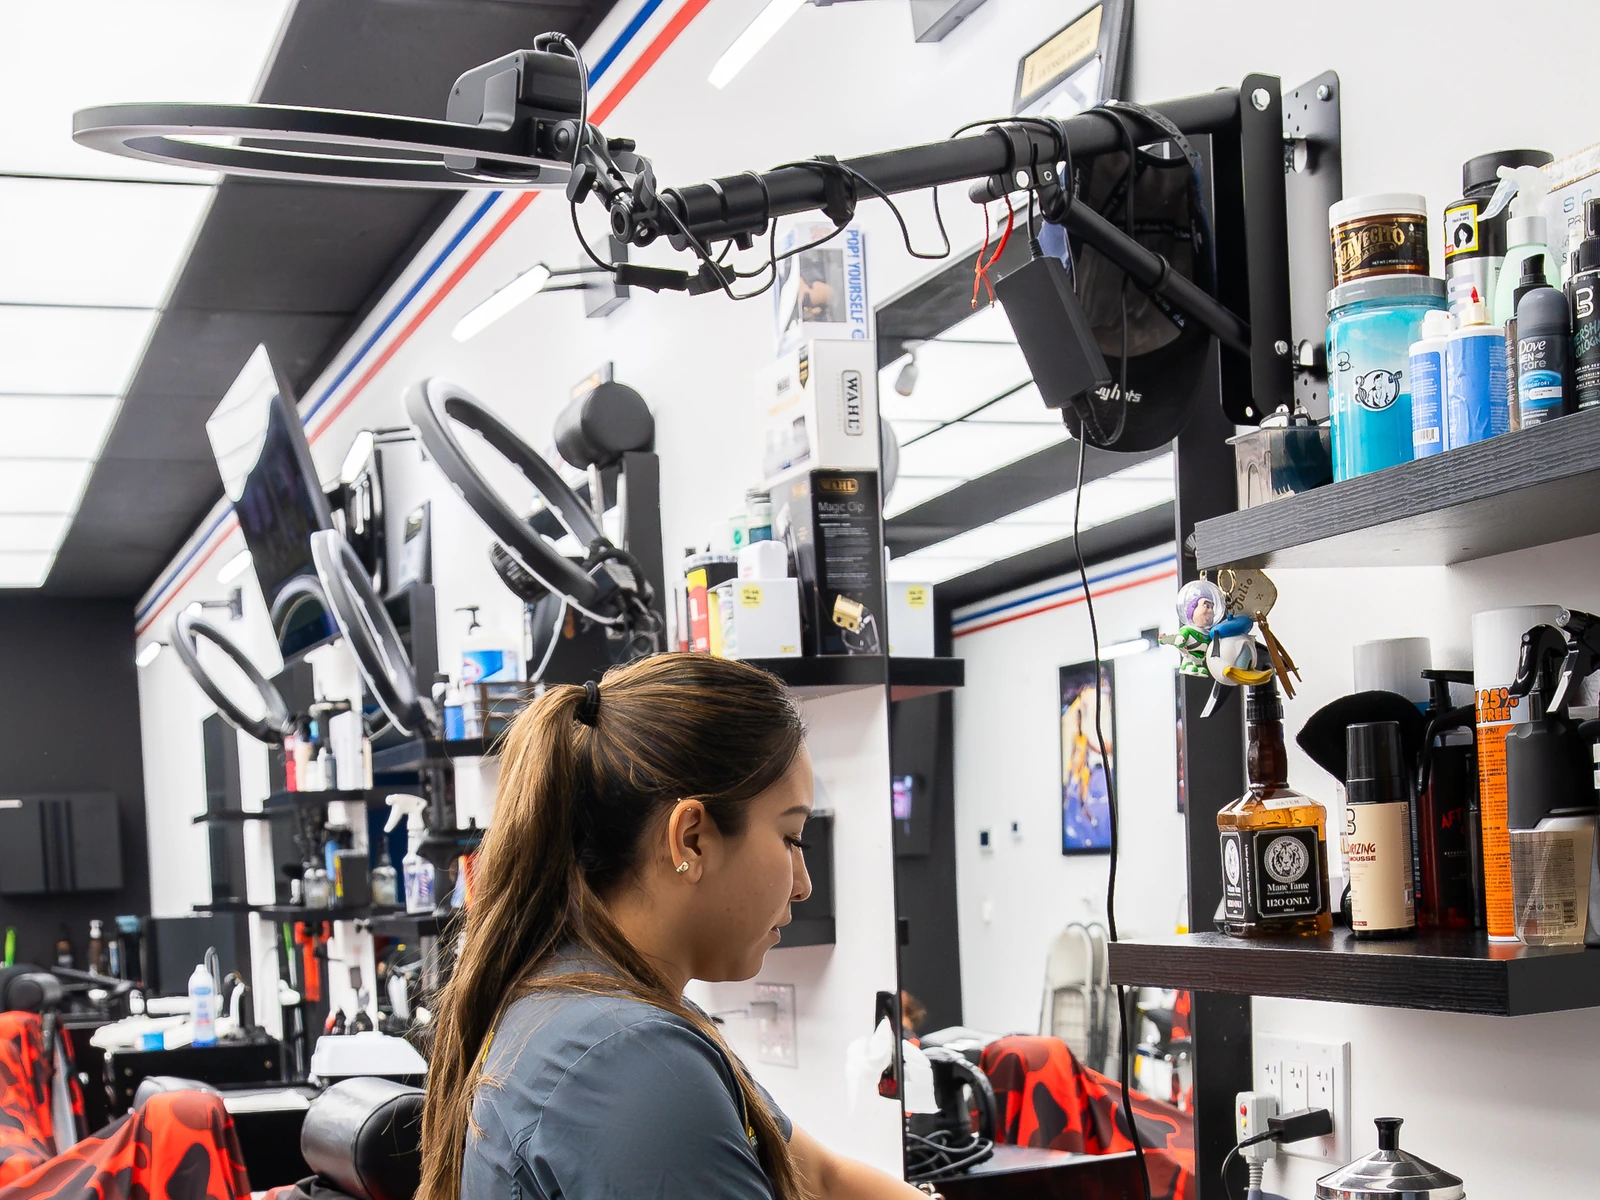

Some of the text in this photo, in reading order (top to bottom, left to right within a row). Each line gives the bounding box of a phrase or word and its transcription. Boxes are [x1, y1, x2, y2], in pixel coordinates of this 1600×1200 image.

[847, 262, 864, 324] YOURSELF
[1520, 340, 1546, 354] Dove
[845, 377, 861, 431] WAHL
[821, 480, 857, 492] WAHL
[818, 501, 865, 514] Magic Clip
[1232, 578, 1253, 611] Julio
[1481, 687, 1520, 708] 25%
[1482, 706, 1512, 723] FREE
[1267, 882, 1310, 892] Mane Tame
[1266, 896, 1312, 907] H2O ONLY
